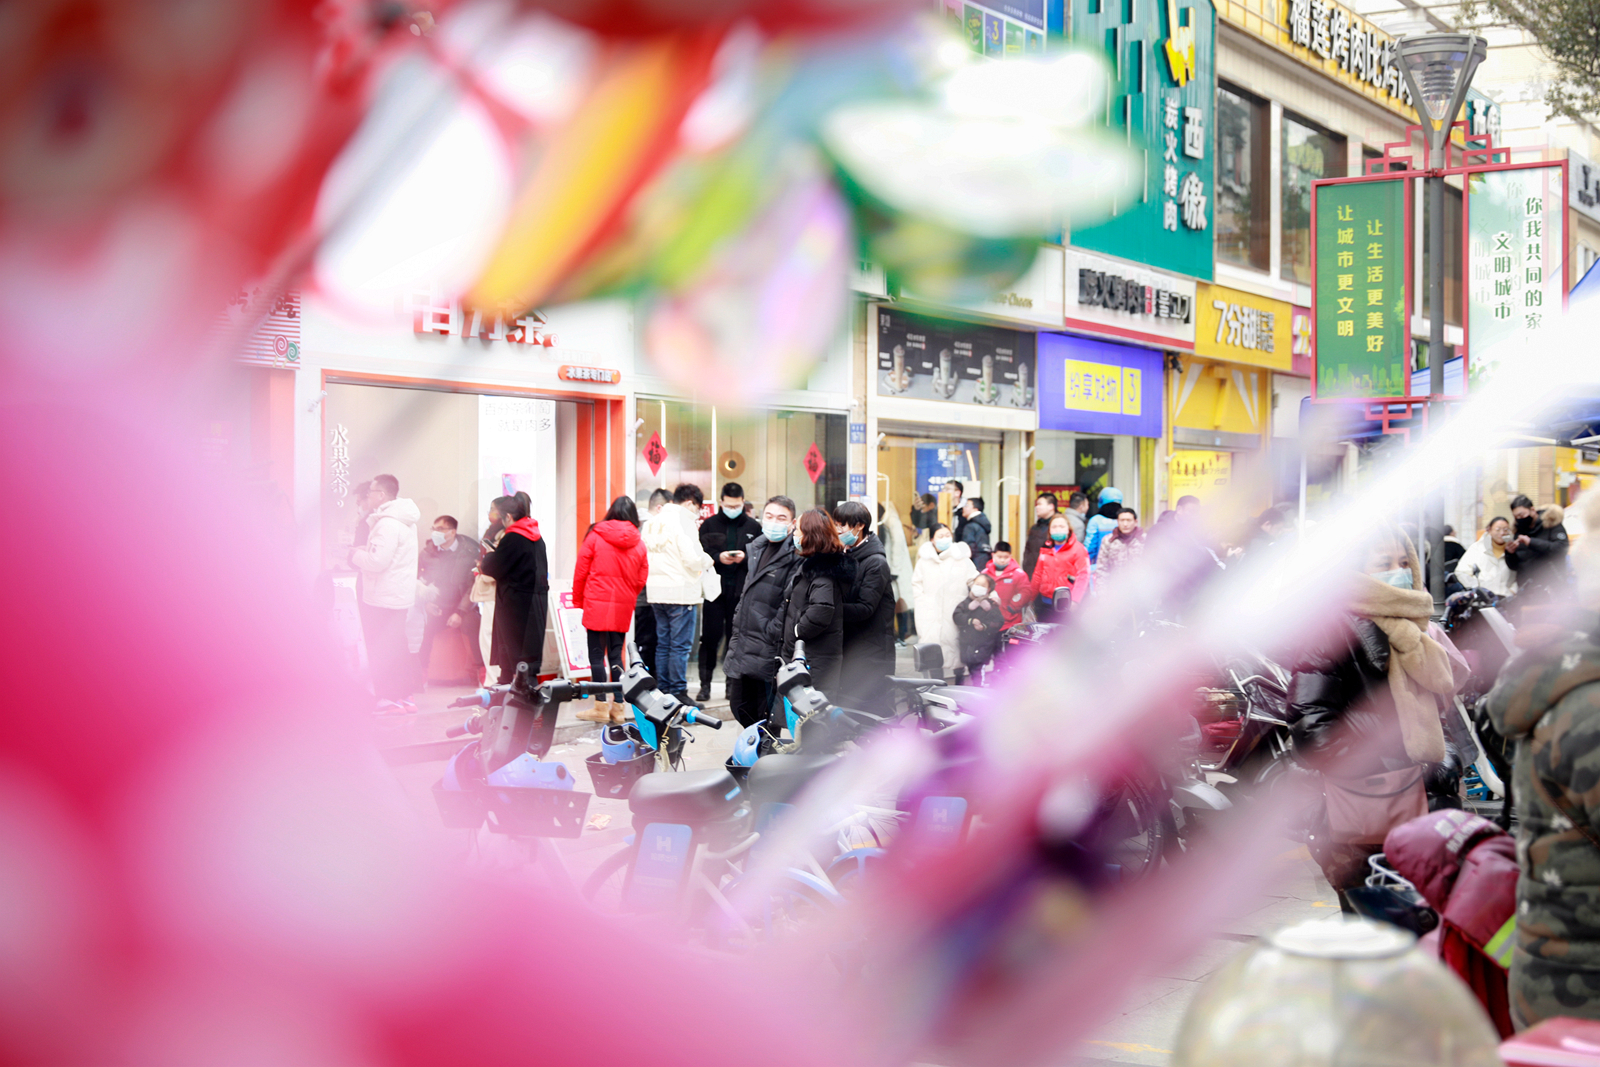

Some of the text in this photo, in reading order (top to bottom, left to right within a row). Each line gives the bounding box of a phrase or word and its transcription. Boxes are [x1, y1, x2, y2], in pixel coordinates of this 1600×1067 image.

[1183, 106, 1208, 231] 西傲
[1213, 300, 1257, 349] 7分甜
[1337, 205, 1354, 337] 让城市更文明
[1366, 219, 1384, 353] 让生活更美好
[1494, 232, 1512, 319] 文明城市
[1525, 197, 1543, 330] 你我共同的家
[656, 835, 672, 852] H
